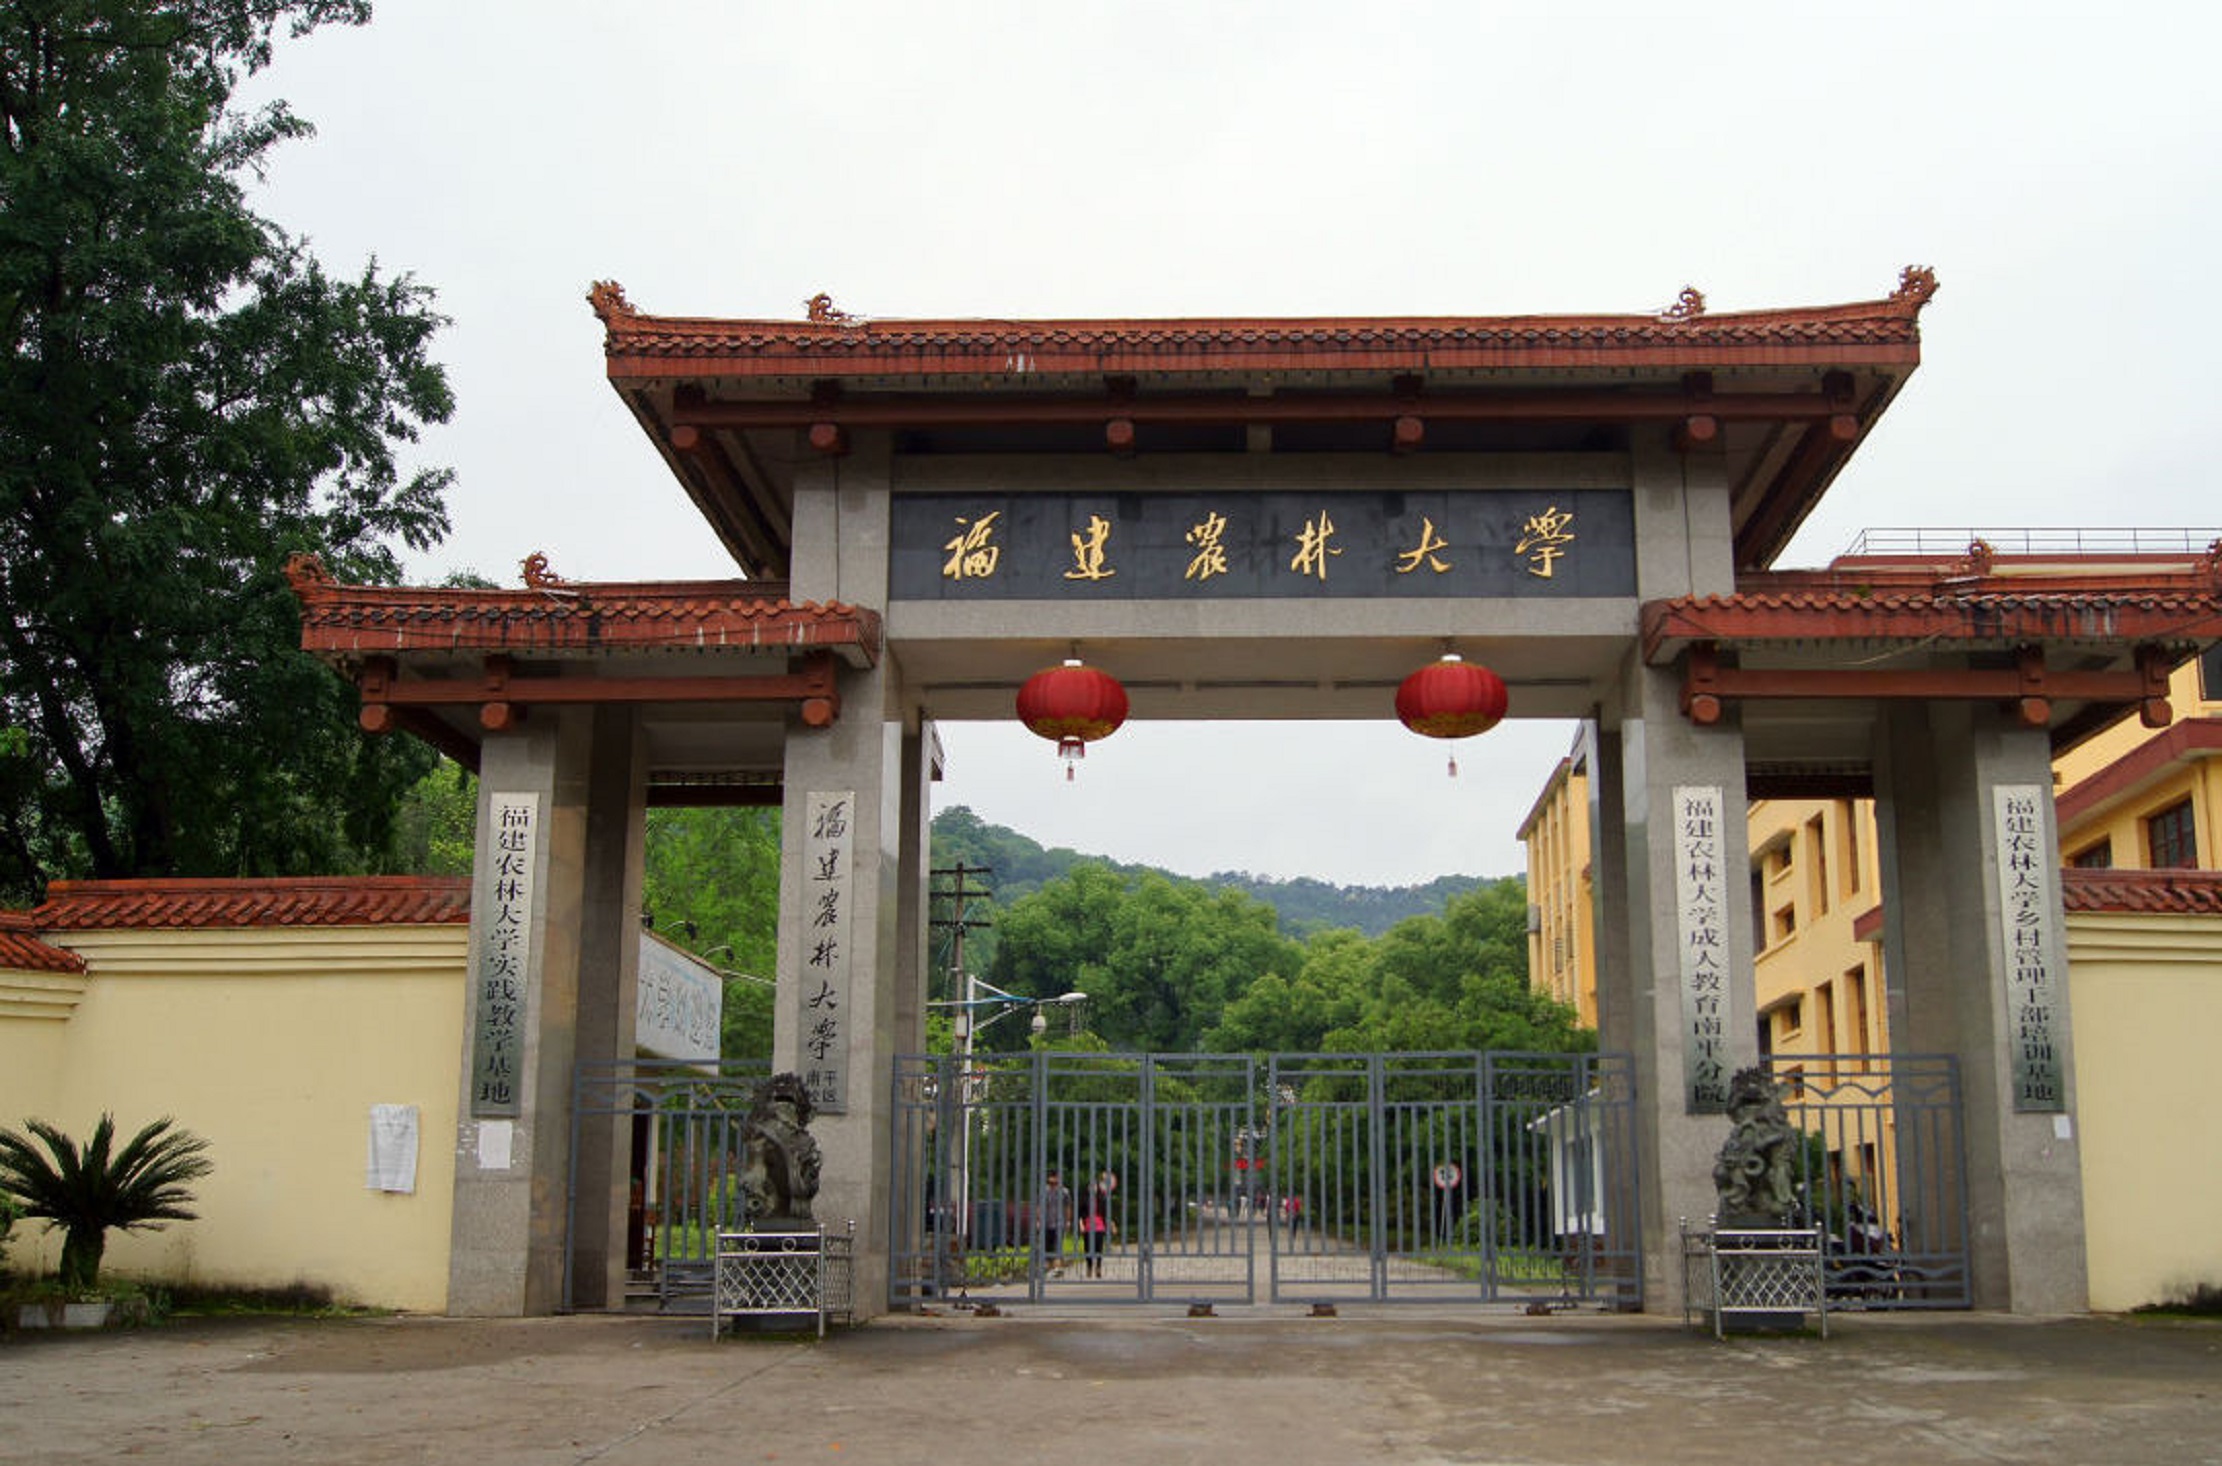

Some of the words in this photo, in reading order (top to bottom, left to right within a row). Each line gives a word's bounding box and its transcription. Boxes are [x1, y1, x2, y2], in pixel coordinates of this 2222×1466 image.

[480, 804, 530, 1105] 福建农林大学实践教学基地
[1685, 797, 1726, 1104] 福建农林大学成人教育南平分院
[2006, 798, 2055, 1101] 福建农林大学乡村管理干部培训基地
